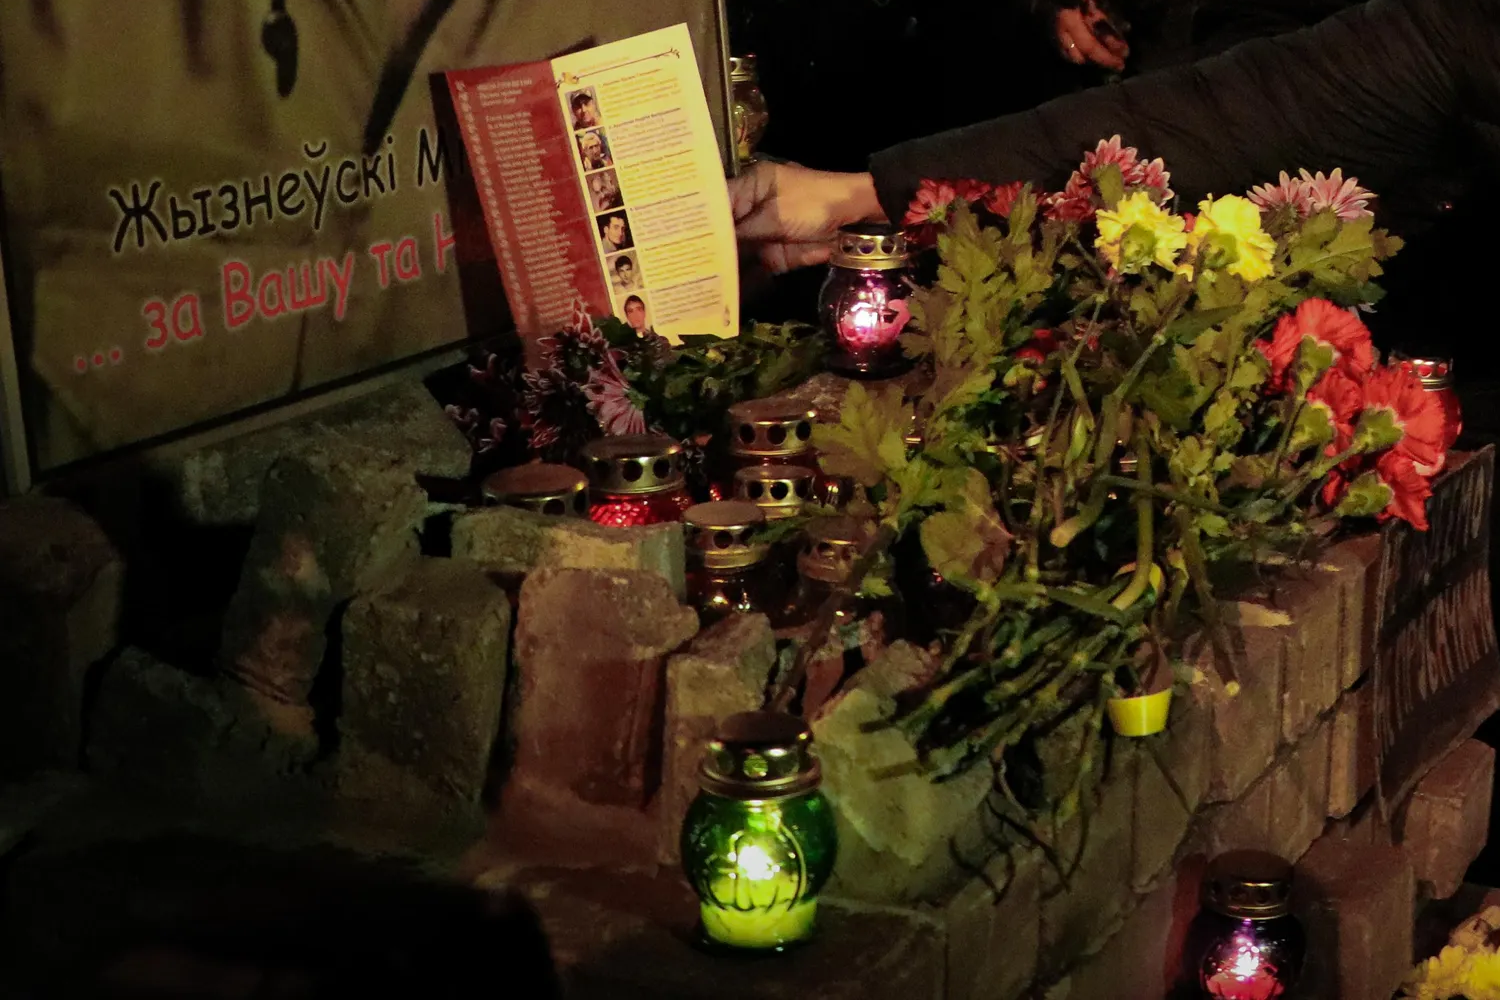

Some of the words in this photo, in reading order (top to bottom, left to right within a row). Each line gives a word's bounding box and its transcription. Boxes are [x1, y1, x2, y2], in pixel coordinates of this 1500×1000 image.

[109, 135, 396, 253] Жызнеўскі
[144, 294, 202, 348] за
[224, 252, 353, 328] Вашу
[371, 238, 421, 287] та
